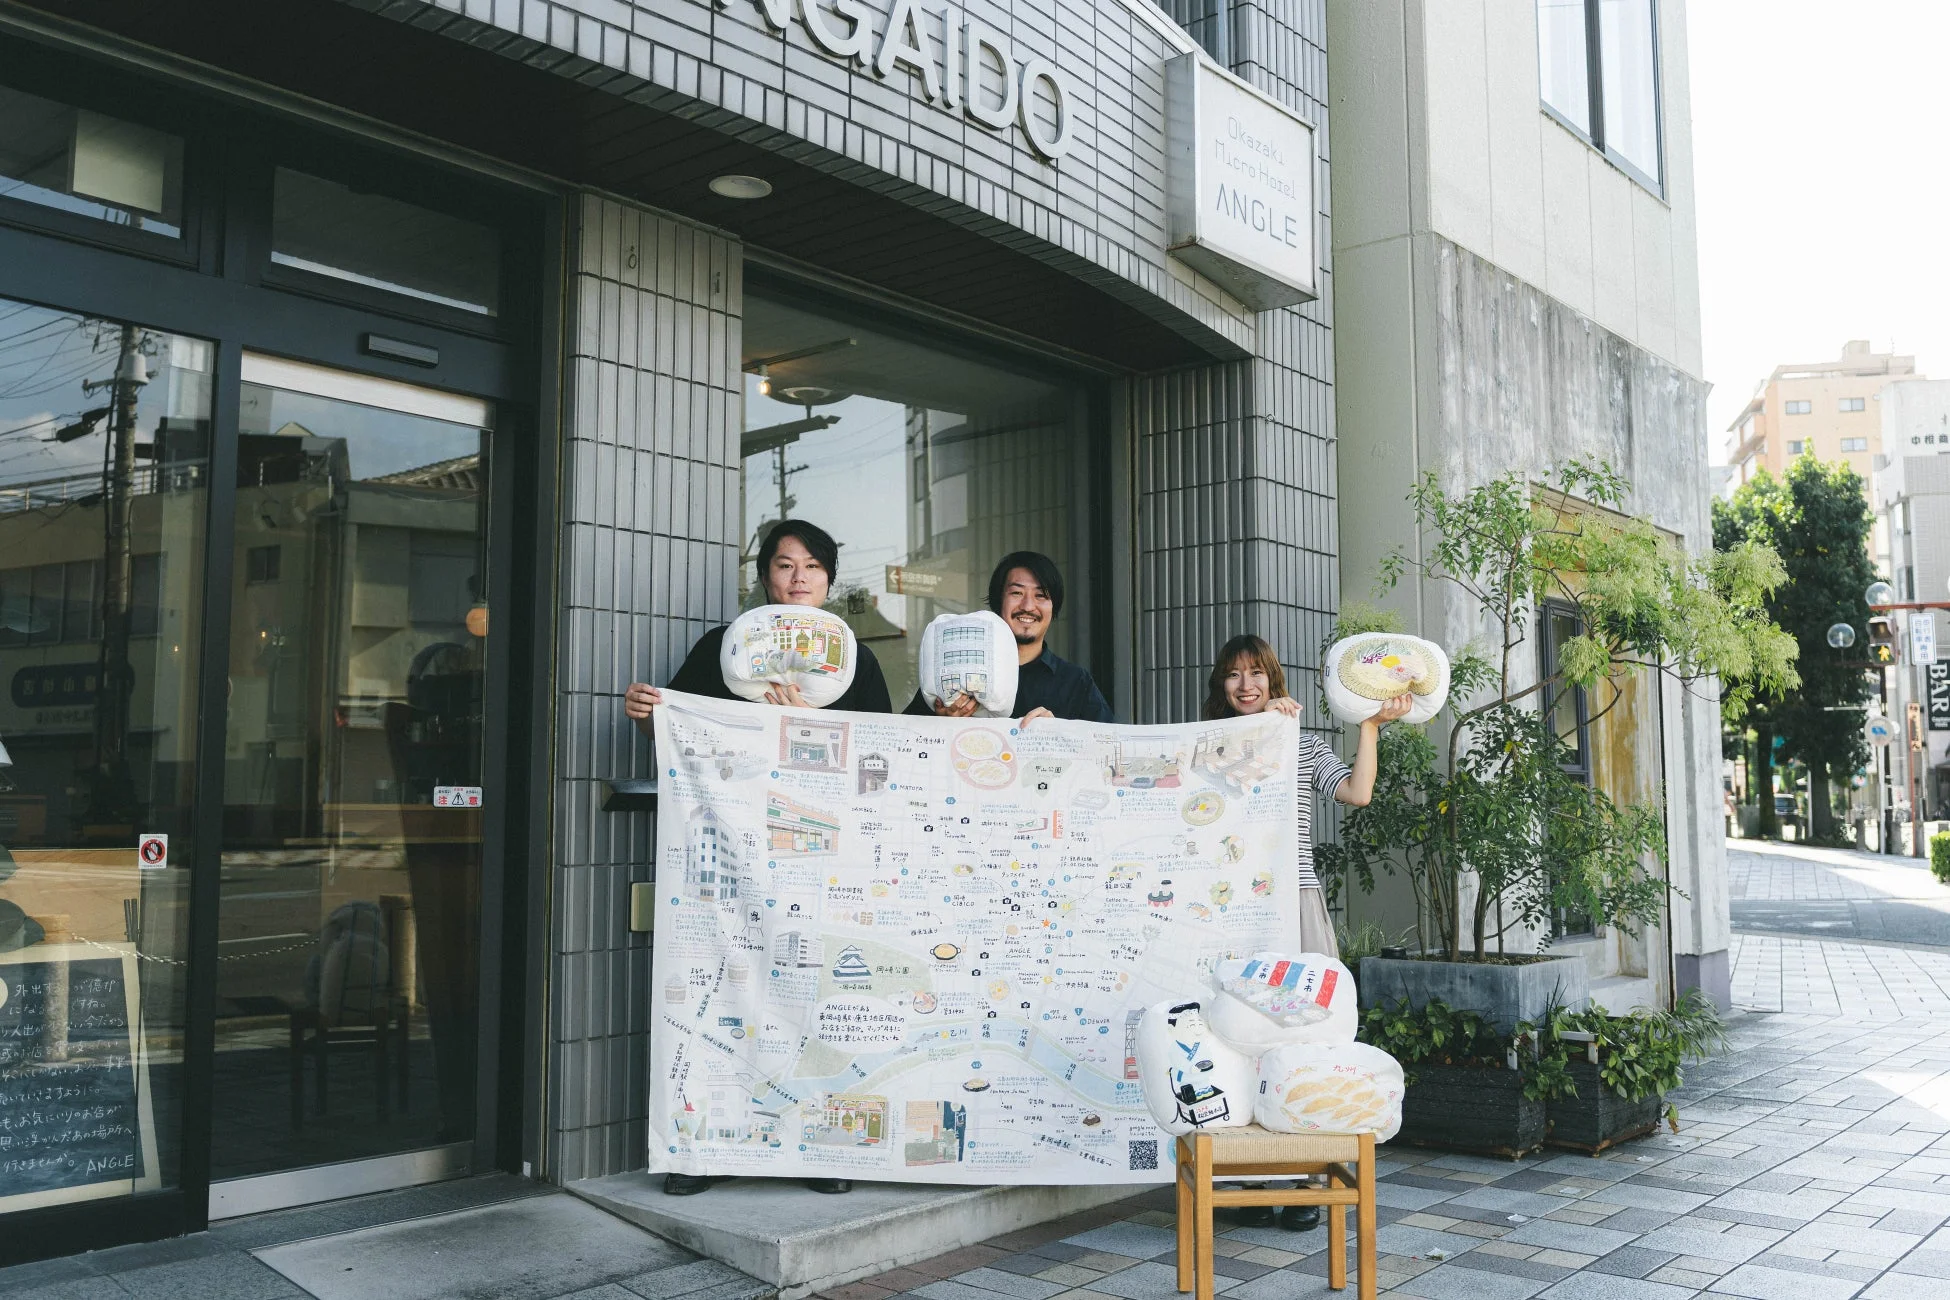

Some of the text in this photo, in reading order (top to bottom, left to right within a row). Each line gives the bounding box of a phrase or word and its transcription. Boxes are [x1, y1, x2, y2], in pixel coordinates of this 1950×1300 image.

[714, 0, 1074, 160] GAIDO
[1229, 116, 1284, 166] Okazaki
[1216, 183, 1297, 249] ANGLE
[1929, 662, 1950, 713] BAR
[438, 796, 448, 805] 注
[1303, 970, 1316, 993] 二七市
[86, 1154, 134, 1177] ANGLE
